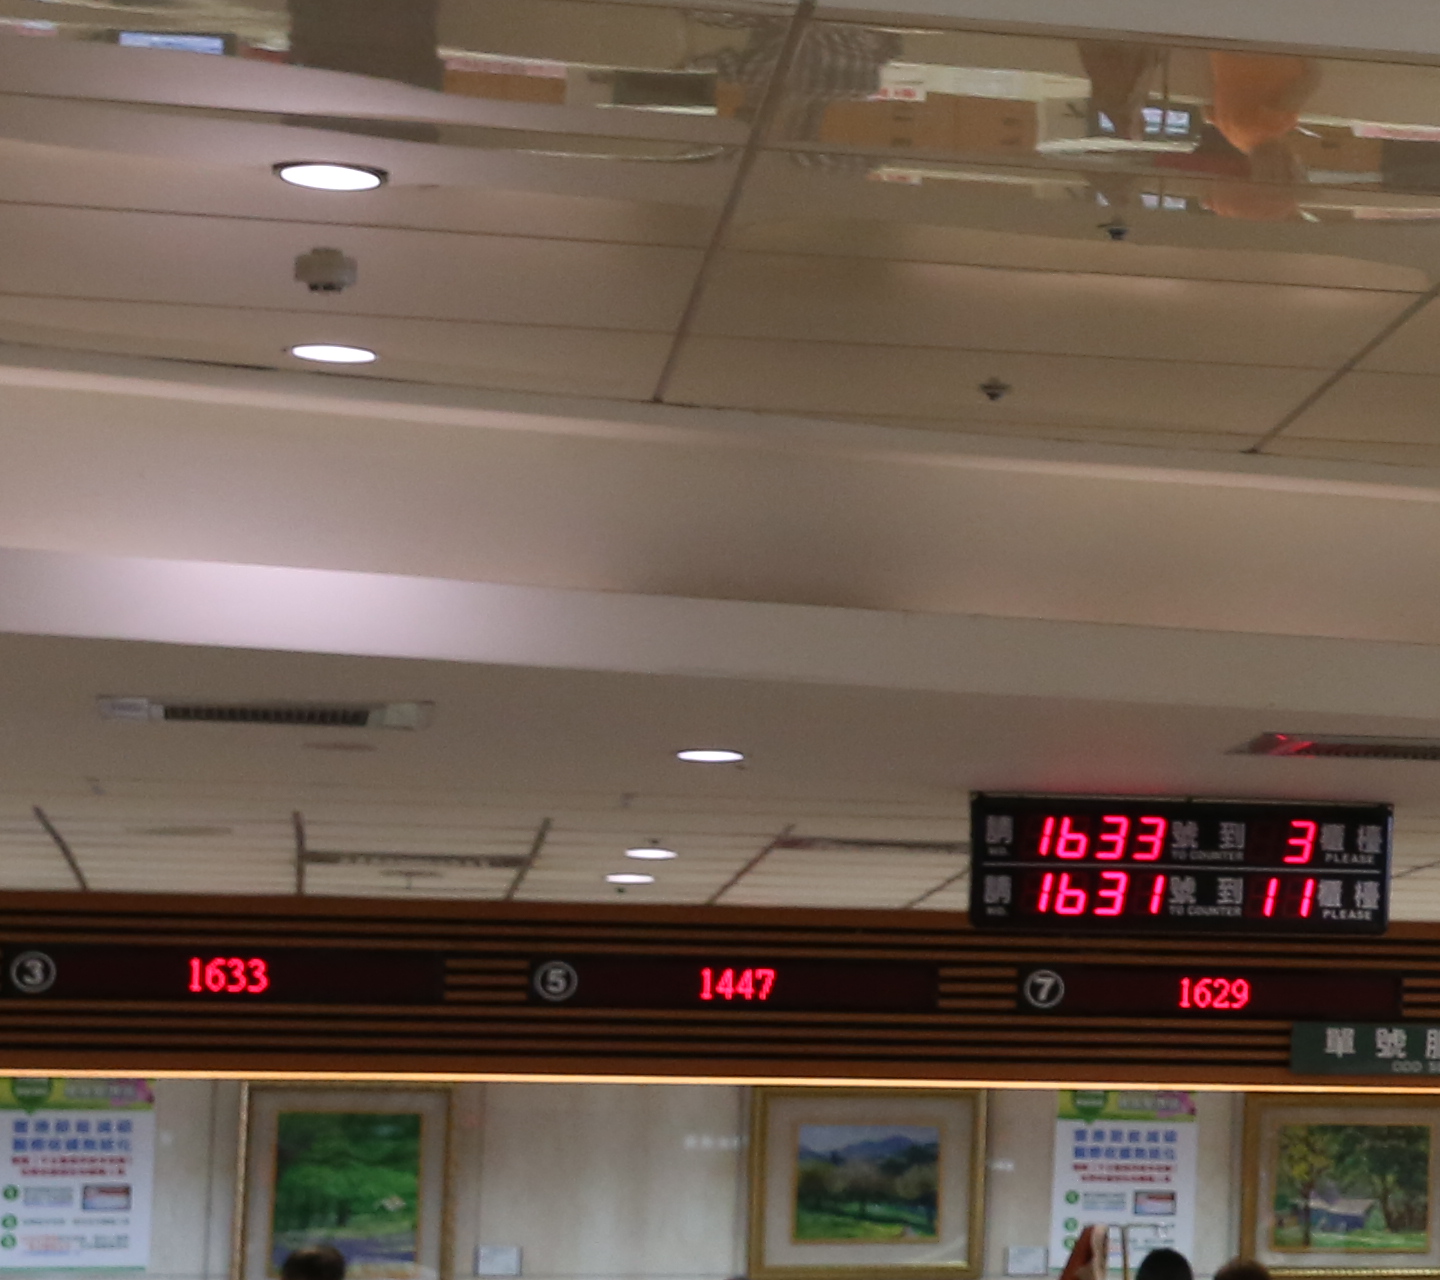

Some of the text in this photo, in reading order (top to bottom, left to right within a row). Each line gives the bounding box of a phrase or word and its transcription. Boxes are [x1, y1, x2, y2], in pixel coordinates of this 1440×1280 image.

[1038, 815, 1168, 861] 1633
[1284, 820, 1318, 864] 3
[1324, 852, 1375, 864] PLEASE
[1037, 871, 1167, 916] 1631
[1262, 877, 1316, 918] 11
[1322, 909, 1373, 920] PLEASE
[189, 957, 270, 993] 1633
[699, 967, 776, 1000] 1447
[1179, 977, 1250, 1009] 1629
